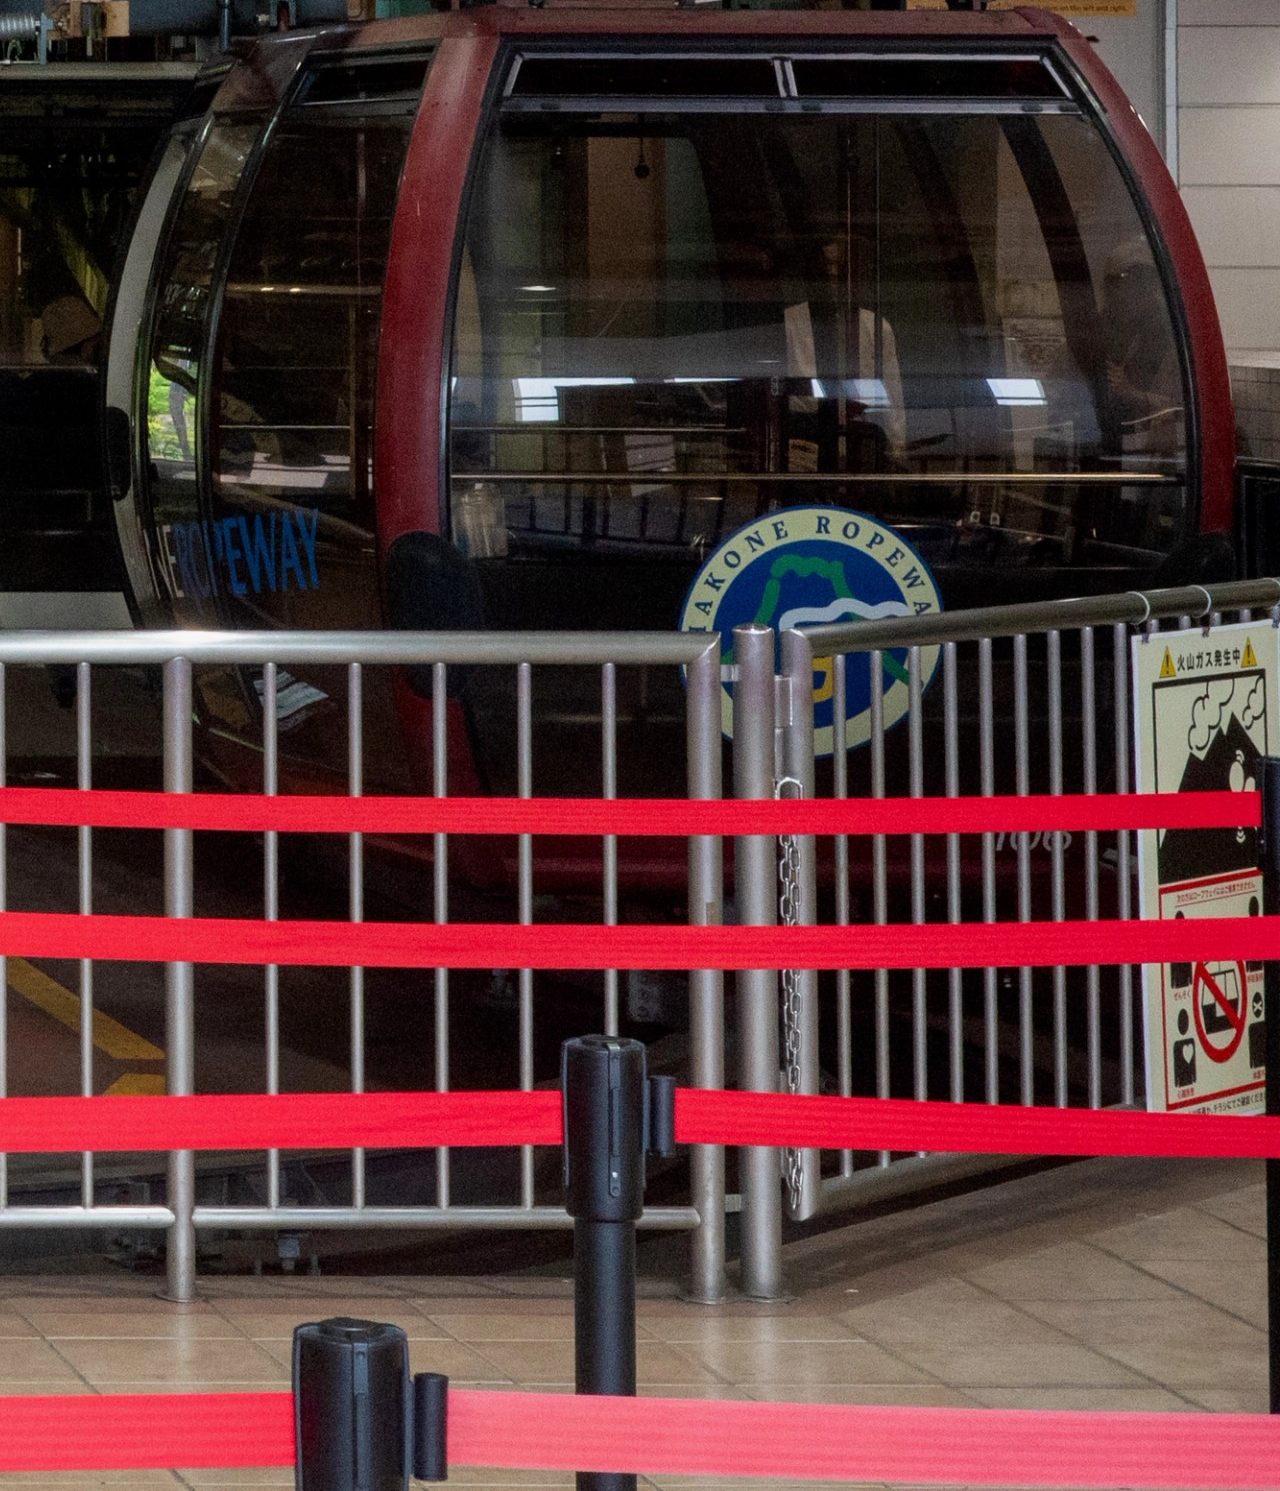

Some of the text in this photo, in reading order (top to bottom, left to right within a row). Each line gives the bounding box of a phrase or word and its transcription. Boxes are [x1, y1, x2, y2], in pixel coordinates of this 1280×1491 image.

[815, 515, 933, 616] ROPEWA
[1177, 647, 1241, 672] 火山ガス発生中
